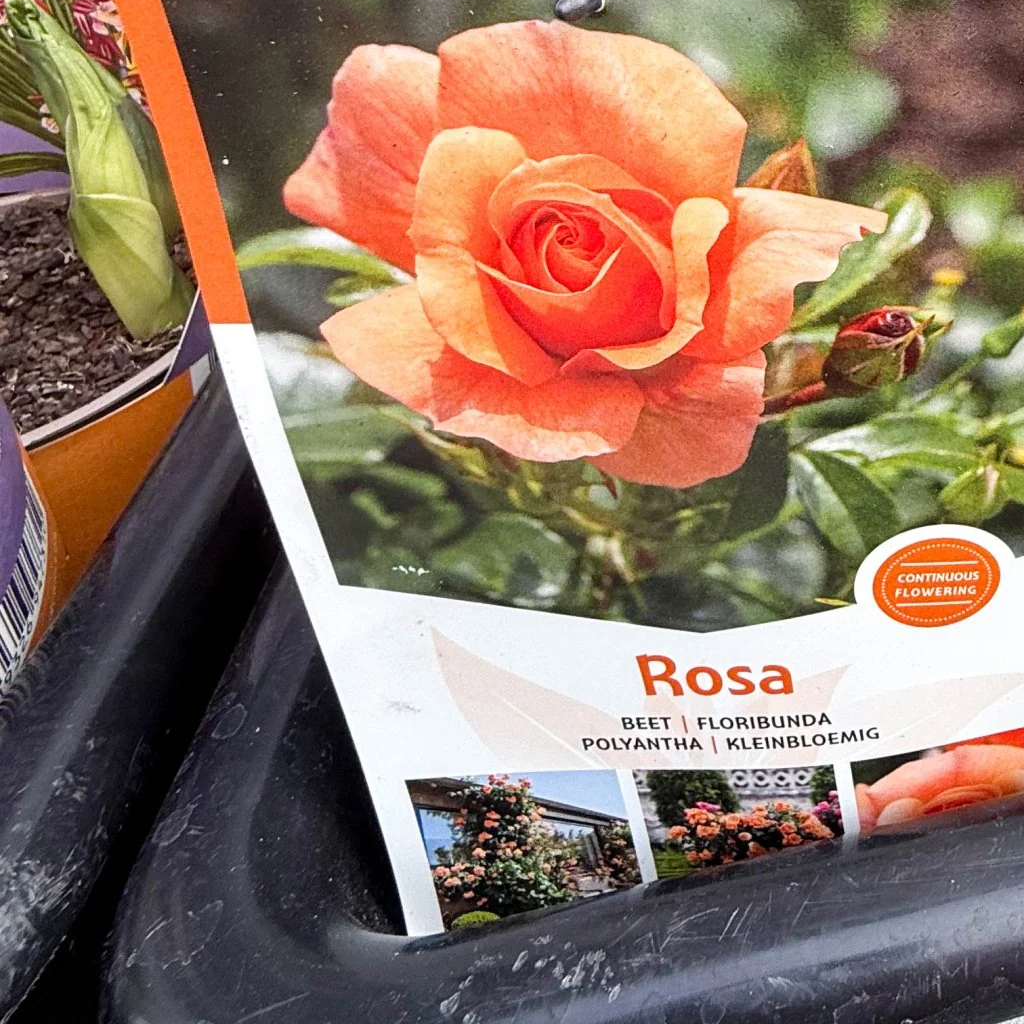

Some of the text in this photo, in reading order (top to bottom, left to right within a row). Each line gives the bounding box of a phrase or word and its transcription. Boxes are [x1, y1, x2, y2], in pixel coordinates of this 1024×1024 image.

[897, 569, 980, 584] CONTINUOUS
[894, 584, 977, 599] FLOWERING
[635, 653, 794, 697] Rosa
[621, 712, 832, 731] BEET FLORIBUNDA
[582, 726, 880, 752] POLYANTHA KLEINBLOEMIG
